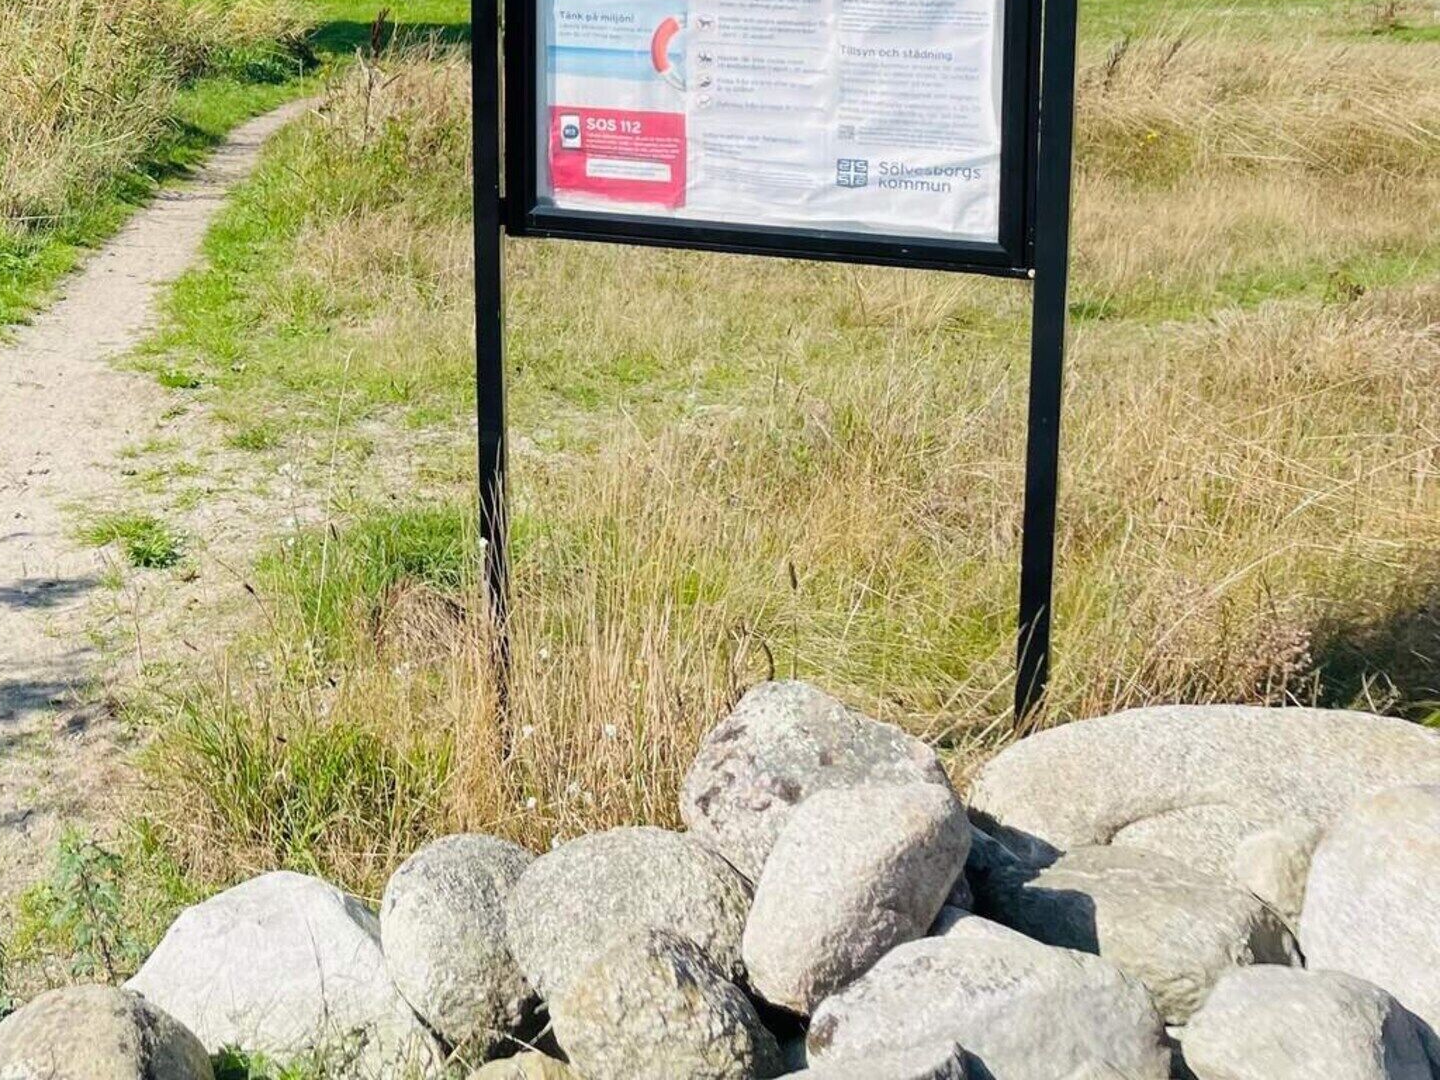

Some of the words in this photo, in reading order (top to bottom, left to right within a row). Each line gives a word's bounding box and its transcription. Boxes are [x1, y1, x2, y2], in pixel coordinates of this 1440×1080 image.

[560, 10, 583, 20] Tänk
[840, 44, 875, 58] Tillsyn
[878, 47, 900, 58] och
[903, 48, 953, 61] städning
[586, 117, 617, 132] SOS
[621, 120, 642, 134] 112
[878, 160, 981, 181] Sölvesborgs
[878, 177, 952, 193] kommun
